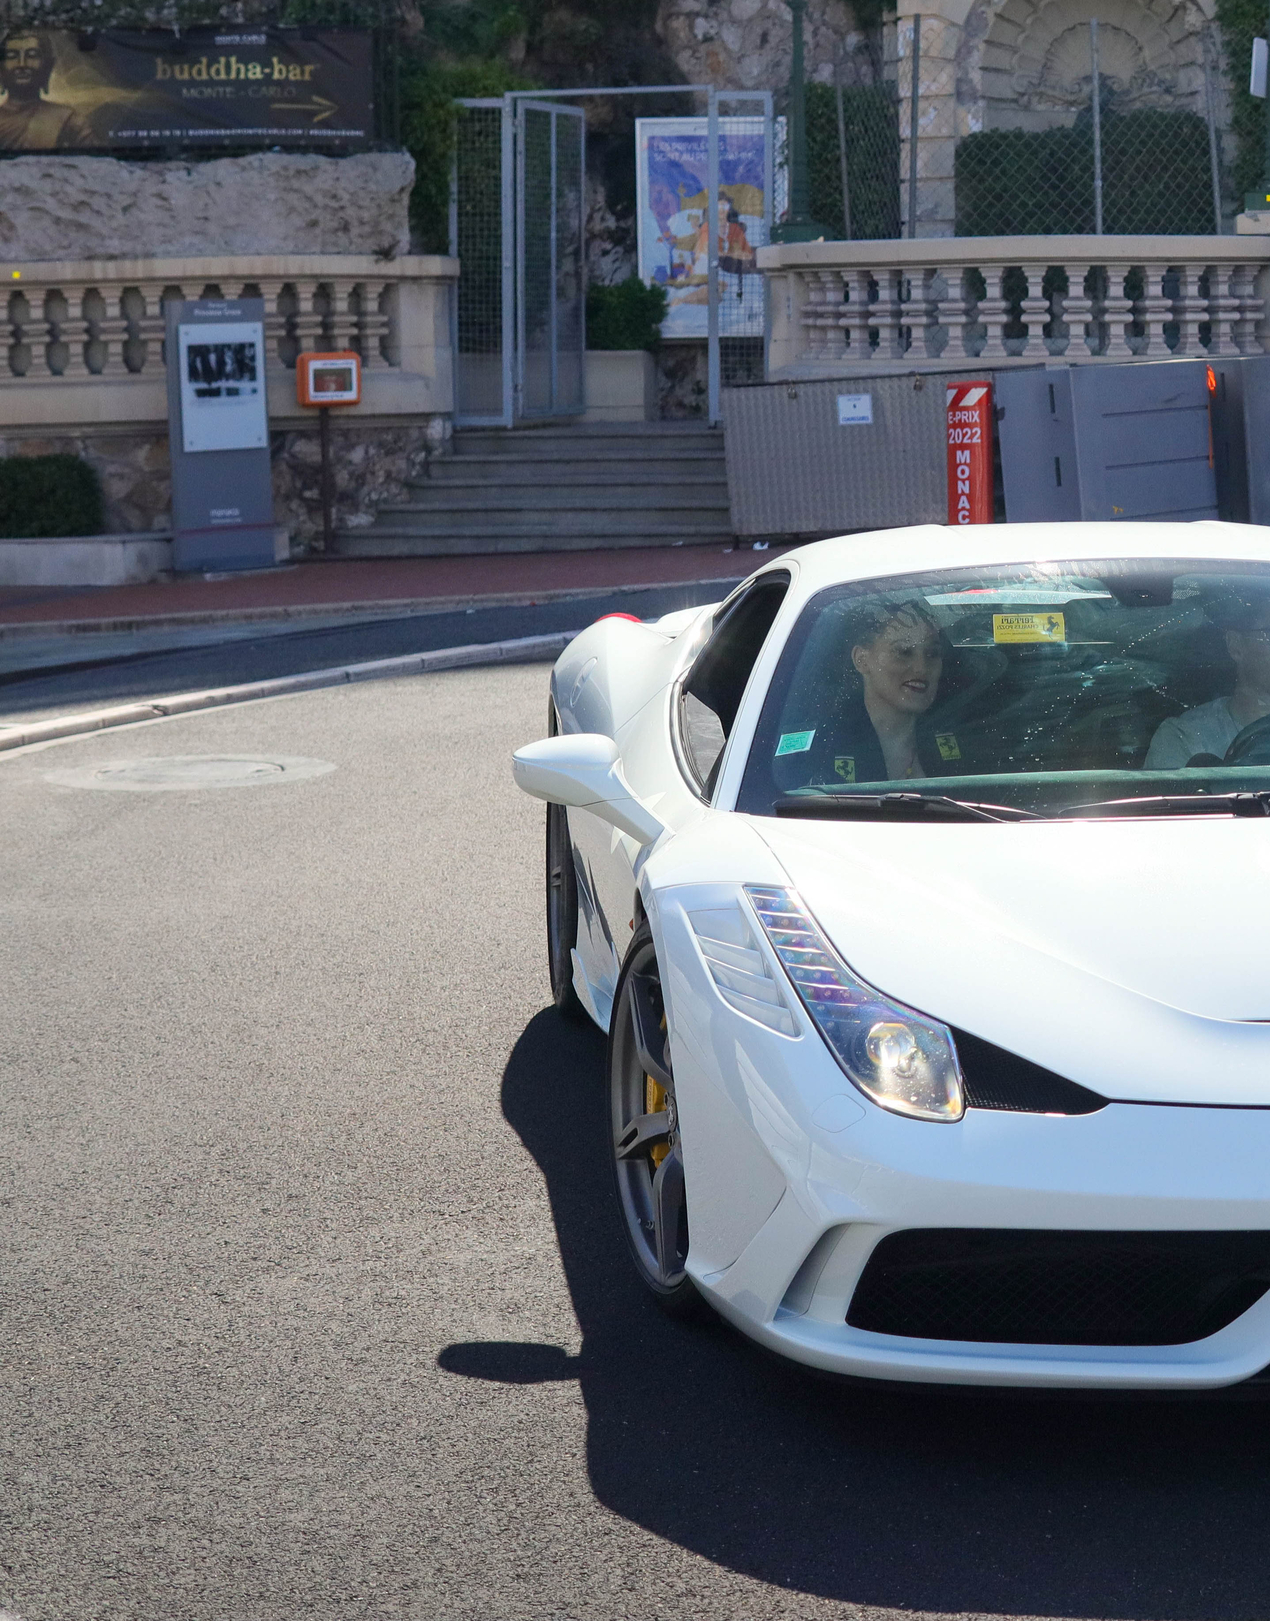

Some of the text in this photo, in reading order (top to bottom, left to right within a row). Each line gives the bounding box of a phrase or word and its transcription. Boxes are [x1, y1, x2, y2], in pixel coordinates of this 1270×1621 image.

[156, 56, 315, 80] buddha-bar
[182, 87, 235, 98] MONTE
[248, 86, 296, 97] CARLO
[948, 411, 980, 424] E-PRIX
[948, 427, 981, 444] 2022
